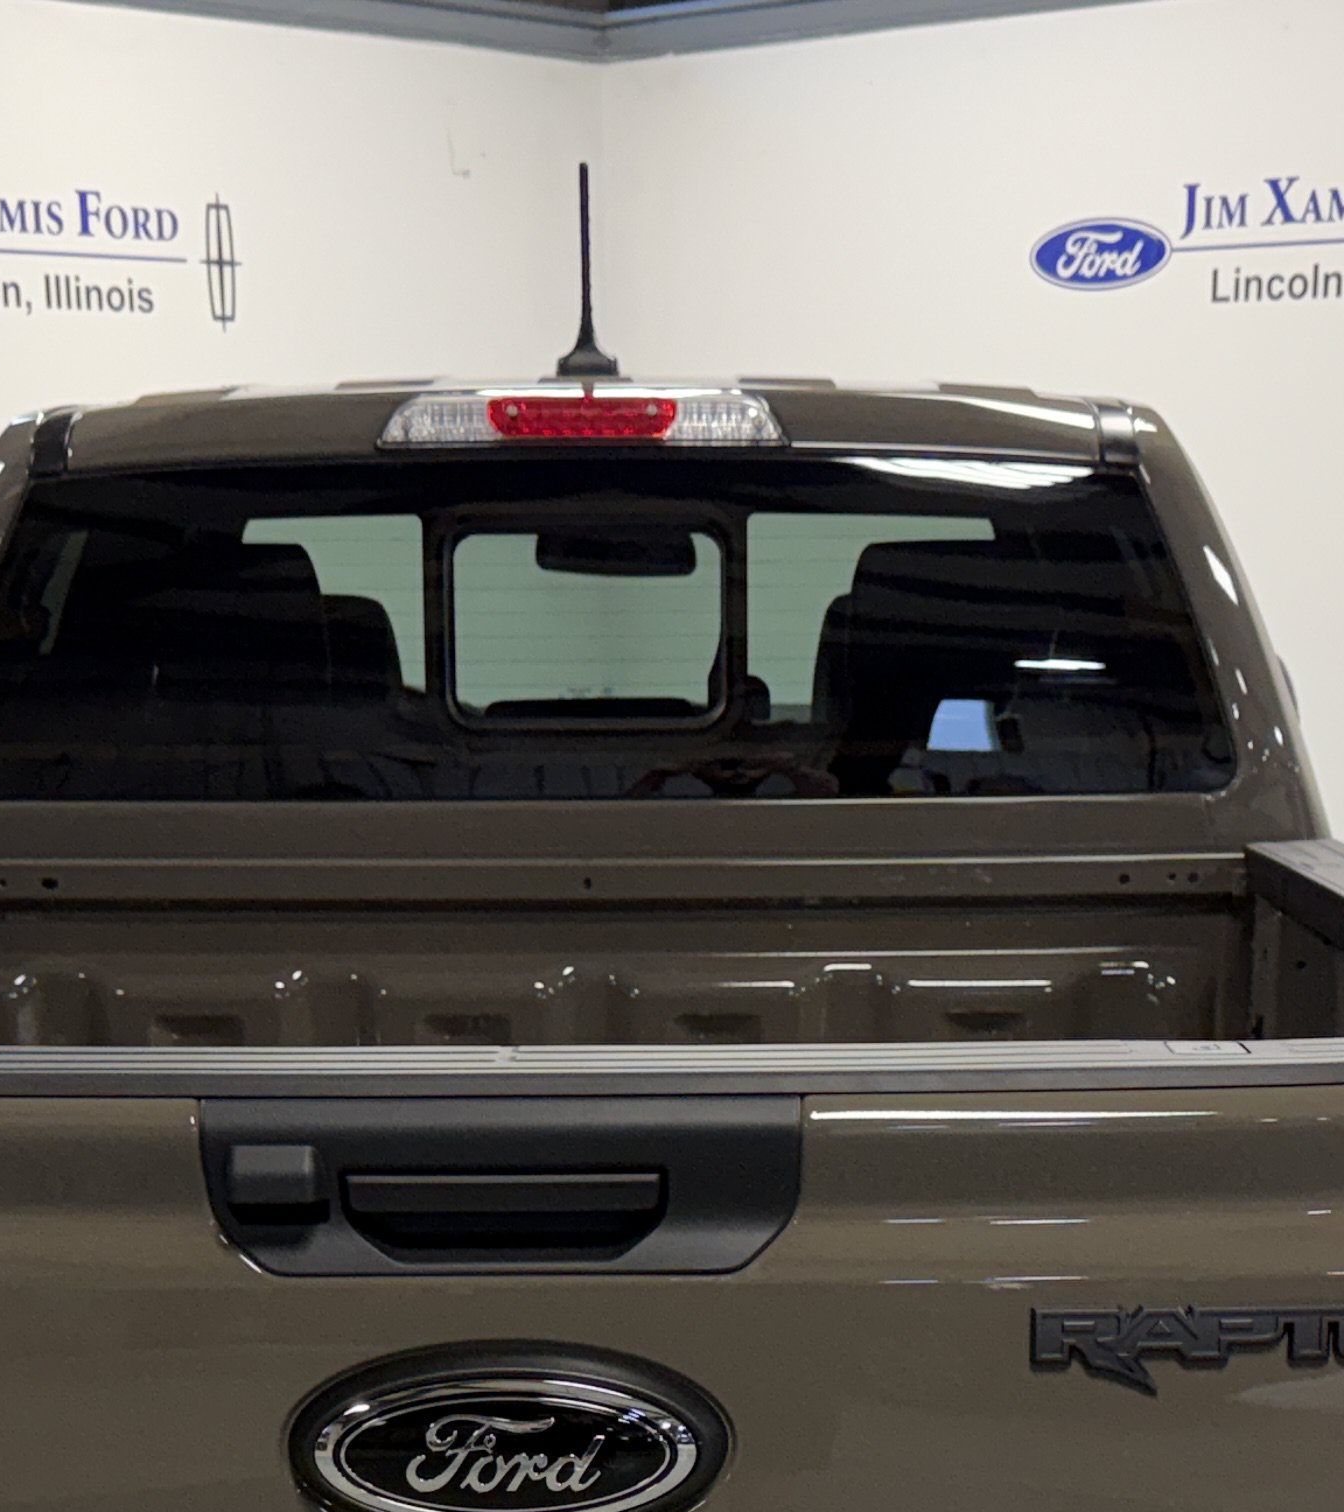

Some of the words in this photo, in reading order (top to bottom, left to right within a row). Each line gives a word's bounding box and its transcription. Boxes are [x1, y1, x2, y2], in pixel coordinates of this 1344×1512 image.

[74, 189, 180, 243] FORD
[1182, 182, 1249, 239] JIM
[1055, 229, 1143, 279] Ford
[44, 274, 156, 314] Illinois
[405, 1414, 606, 1493] Ford
